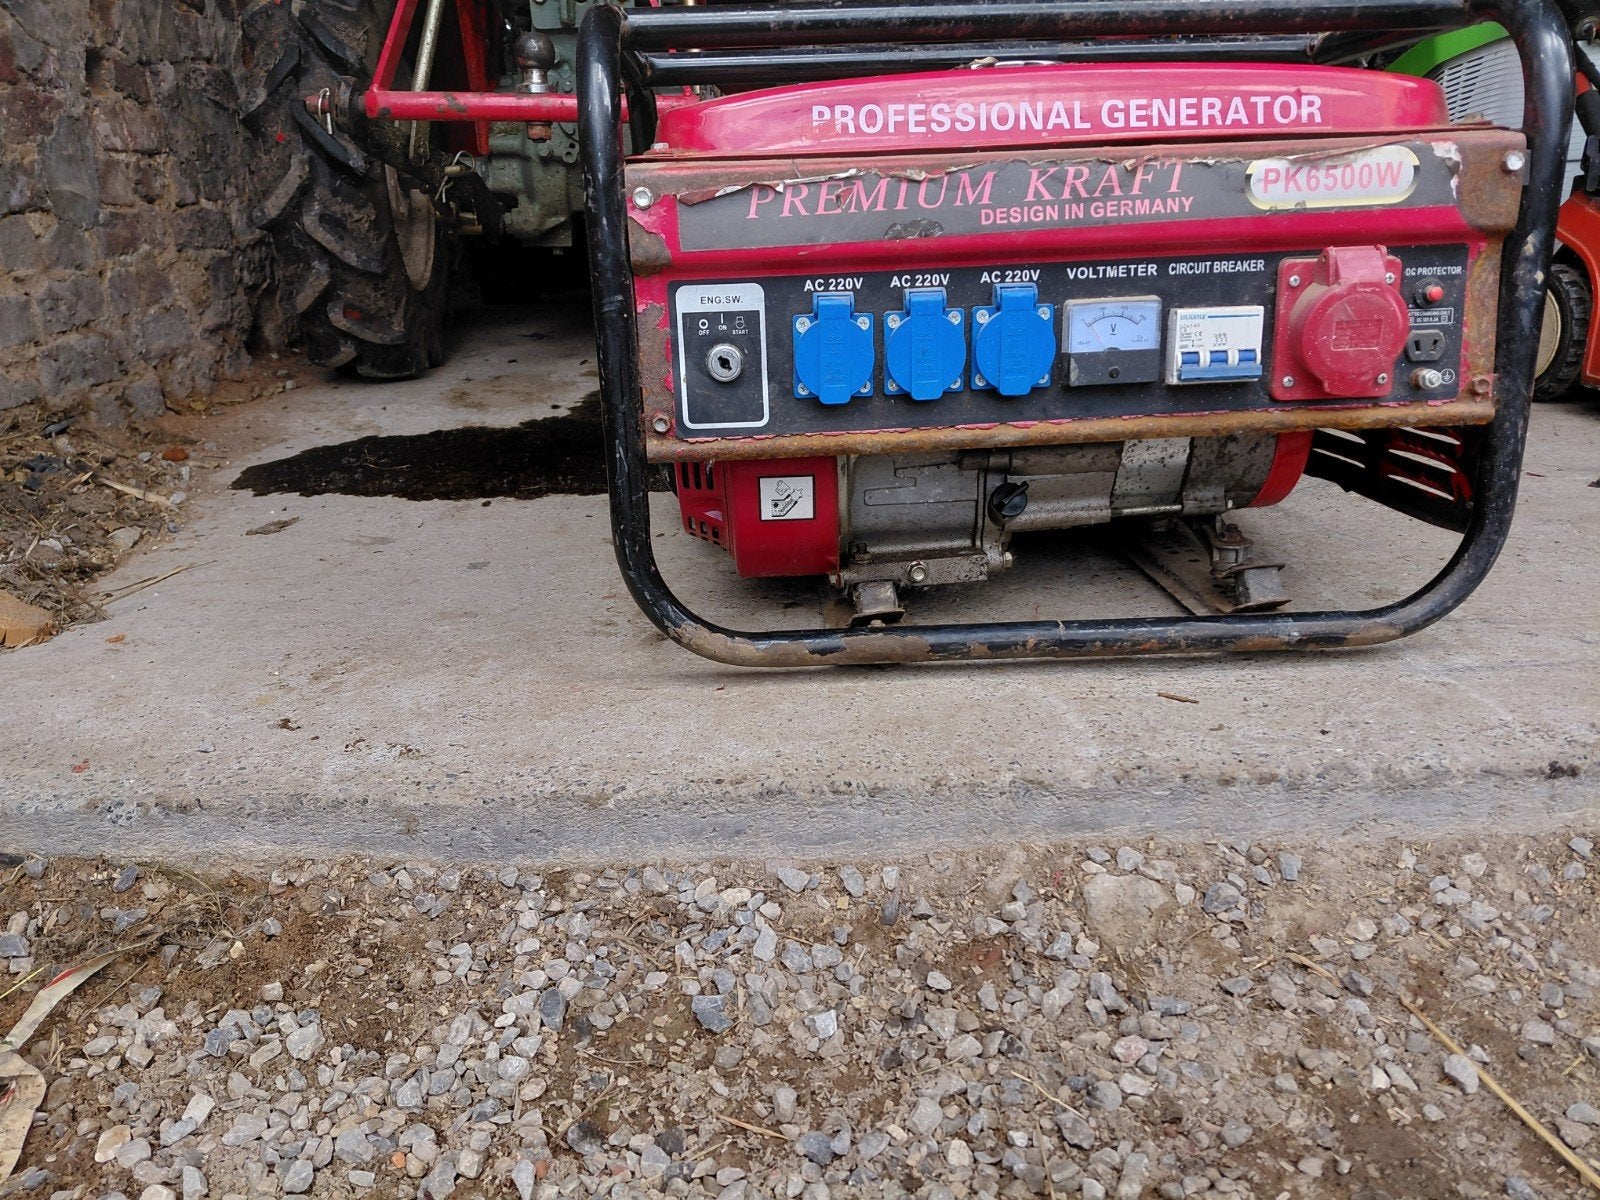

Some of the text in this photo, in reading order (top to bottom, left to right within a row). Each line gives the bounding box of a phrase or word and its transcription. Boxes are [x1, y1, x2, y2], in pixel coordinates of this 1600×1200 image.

[812, 95, 1322, 134] PROFESSIONAL GENERATOR
[1263, 161, 1403, 194] PK6500W
[746, 161, 1185, 219] PREMIUM KRAFT
[980, 196, 1194, 225] DESIGN IN GERMANY
[1067, 263, 1158, 280] VOLTMETER
[1168, 259, 1265, 276] CIRCUIT BREAKER
[1405, 265, 1462, 276] DC PROTECTOR
[804, 276, 864, 291] AC 220V
[890, 272, 951, 288] AC 220V
[980, 269, 1040, 284] AC 220V
[700, 295, 743, 305] ENG.SW.
